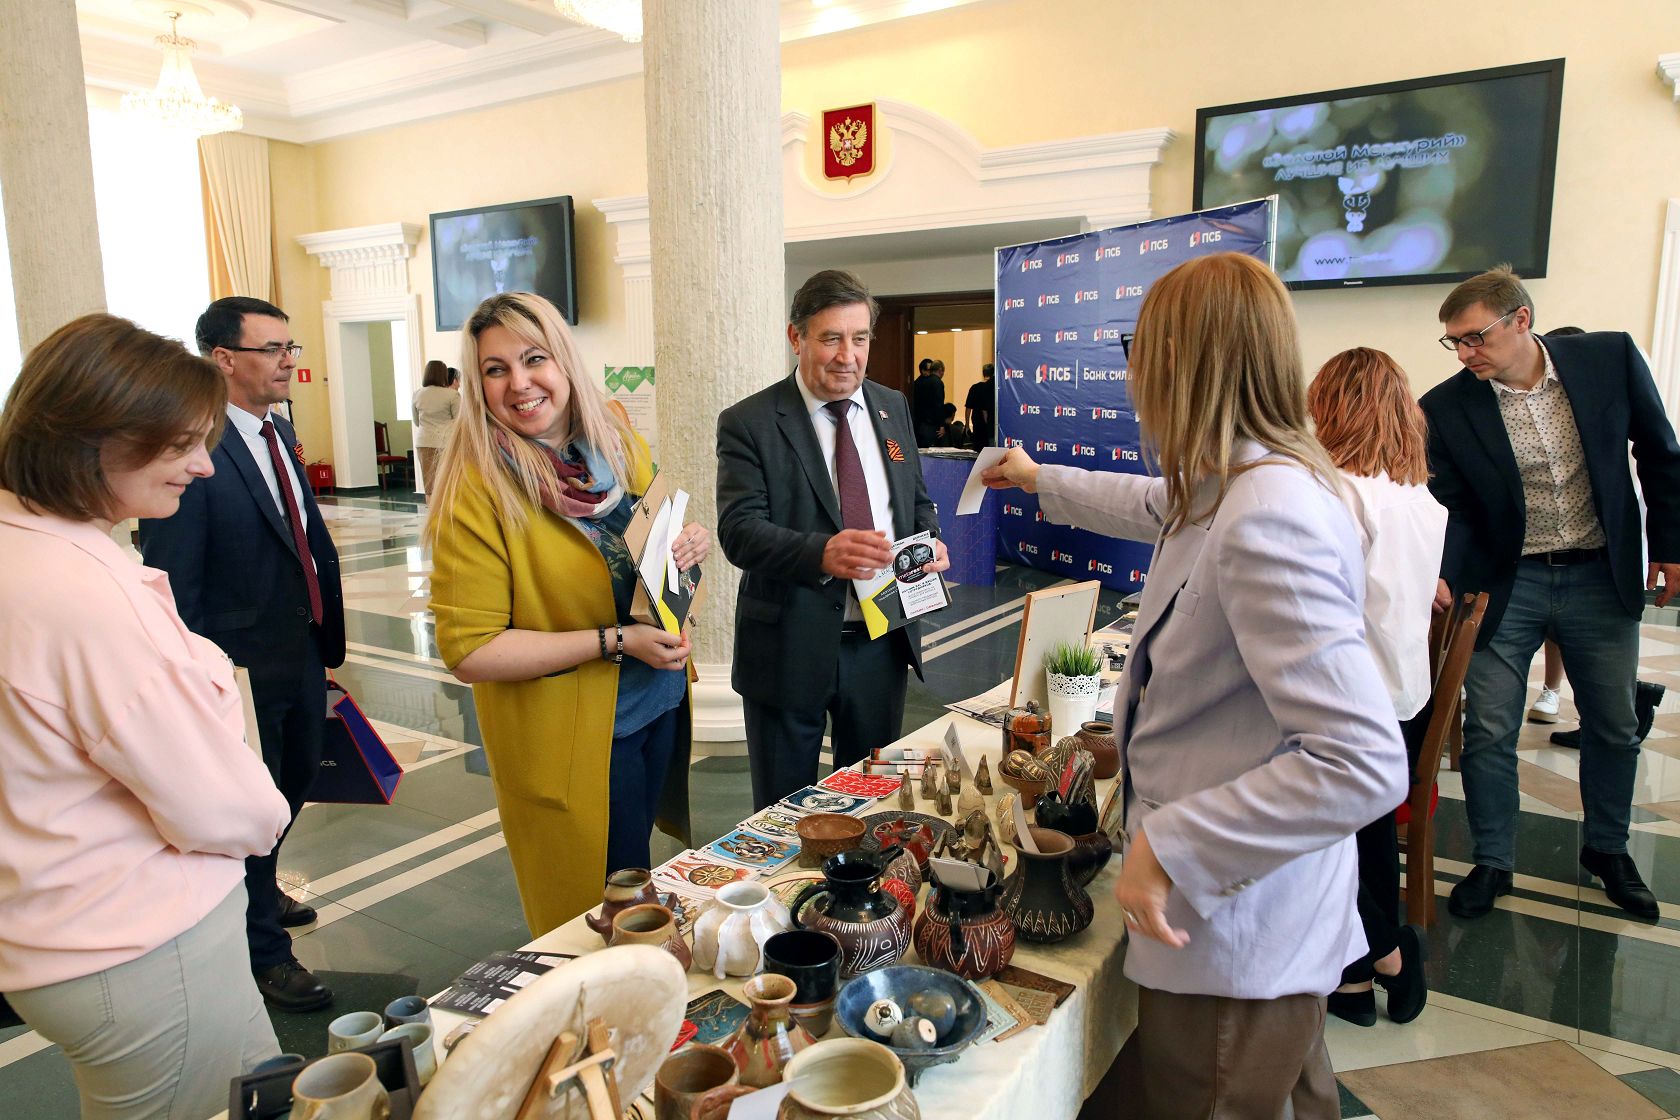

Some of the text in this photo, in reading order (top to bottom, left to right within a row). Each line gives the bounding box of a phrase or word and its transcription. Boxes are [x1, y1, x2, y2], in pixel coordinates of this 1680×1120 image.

[1201, 230, 1222, 244] ПСБ
[1150, 238, 1169, 252] ПСБ
[1104, 246, 1121, 258] ПСБ
[1029, 259, 1043, 270] ПСБ
[1065, 253, 1080, 265] ПСБ
[1083, 290, 1099, 301] ПСБ
[1125, 285, 1143, 297] ПСБ
[1012, 298, 1025, 308] ПСБ
[1046, 294, 1060, 305] ПСБ
[1028, 333, 1041, 343] ПСБ
[1063, 331, 1078, 341] ПСБ
[1103, 329, 1119, 340] ПСБ
[1011, 369, 1024, 379] ПСБ
[1049, 367, 1071, 381] ПСБ
[1083, 368, 1107, 380] Банк
[1027, 405, 1041, 415] ПСБ
[1062, 406, 1077, 417] ПСБ
[1101, 408, 1117, 419] ПСБ
[1010, 438, 1024, 448] ПСБ
[1044, 442, 1058, 452] ПСБ
[1080, 446, 1096, 457] ПСБ
[1121, 450, 1139, 461] ПСБ
[1010, 506, 1023, 517] ПСБ
[1025, 543, 1038, 555] ПСБ
[1059, 552, 1073, 564] ПСБ
[1096, 562, 1113, 575] ПСБ
